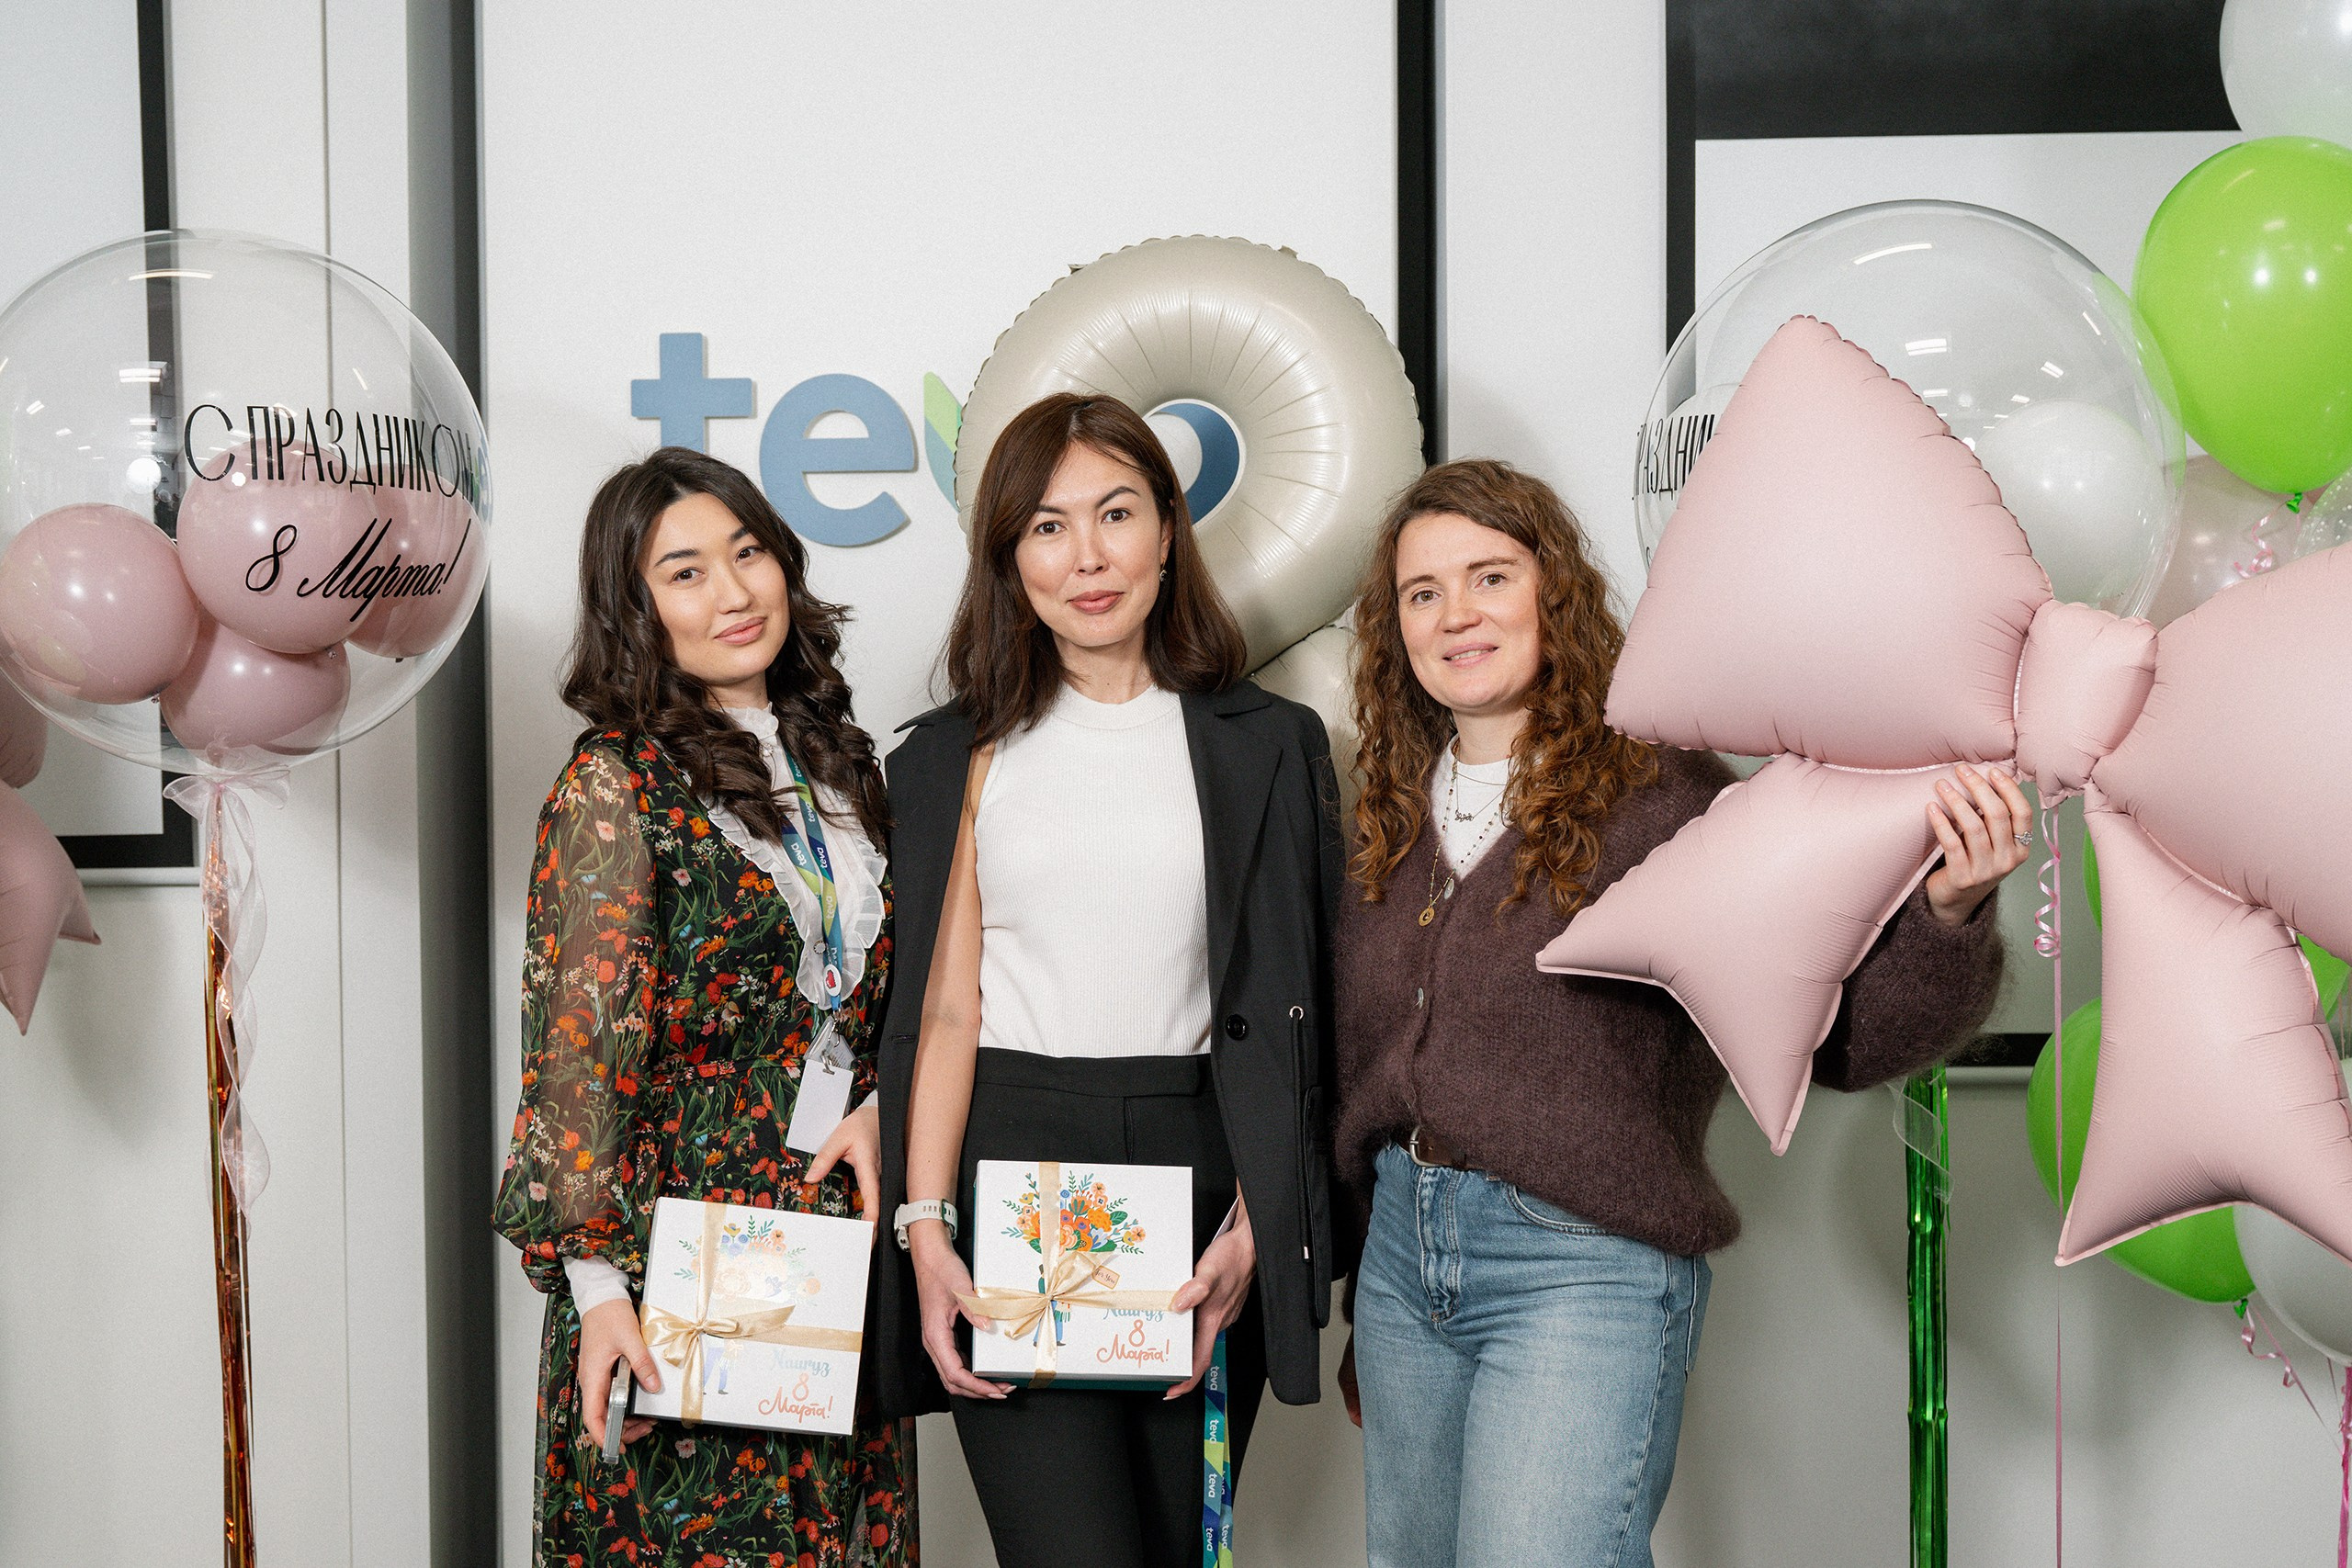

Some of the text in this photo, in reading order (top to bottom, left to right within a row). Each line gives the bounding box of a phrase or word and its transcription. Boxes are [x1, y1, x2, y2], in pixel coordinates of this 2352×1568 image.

[184, 403, 235, 481] С
[246, 405, 474, 503] ПРАЗДНИКОМ
[245, 517, 472, 623] 8 Марта!
[790, 842, 808, 867] teva
[817, 847, 828, 869] teva
[826, 896, 835, 919] teva
[1128, 1319, 1146, 1348] 8
[1096, 1334, 1170, 1369] Марта!
[792, 1372, 809, 1402] 8
[1210, 1365, 1220, 1391] teva
[758, 1385, 833, 1424] Марта!
[1209, 1419, 1219, 1445] teva
[1208, 1472, 1218, 1498] teva
[1205, 1527, 1214, 1552] teva
[1221, 1524, 1230, 1550] teva
